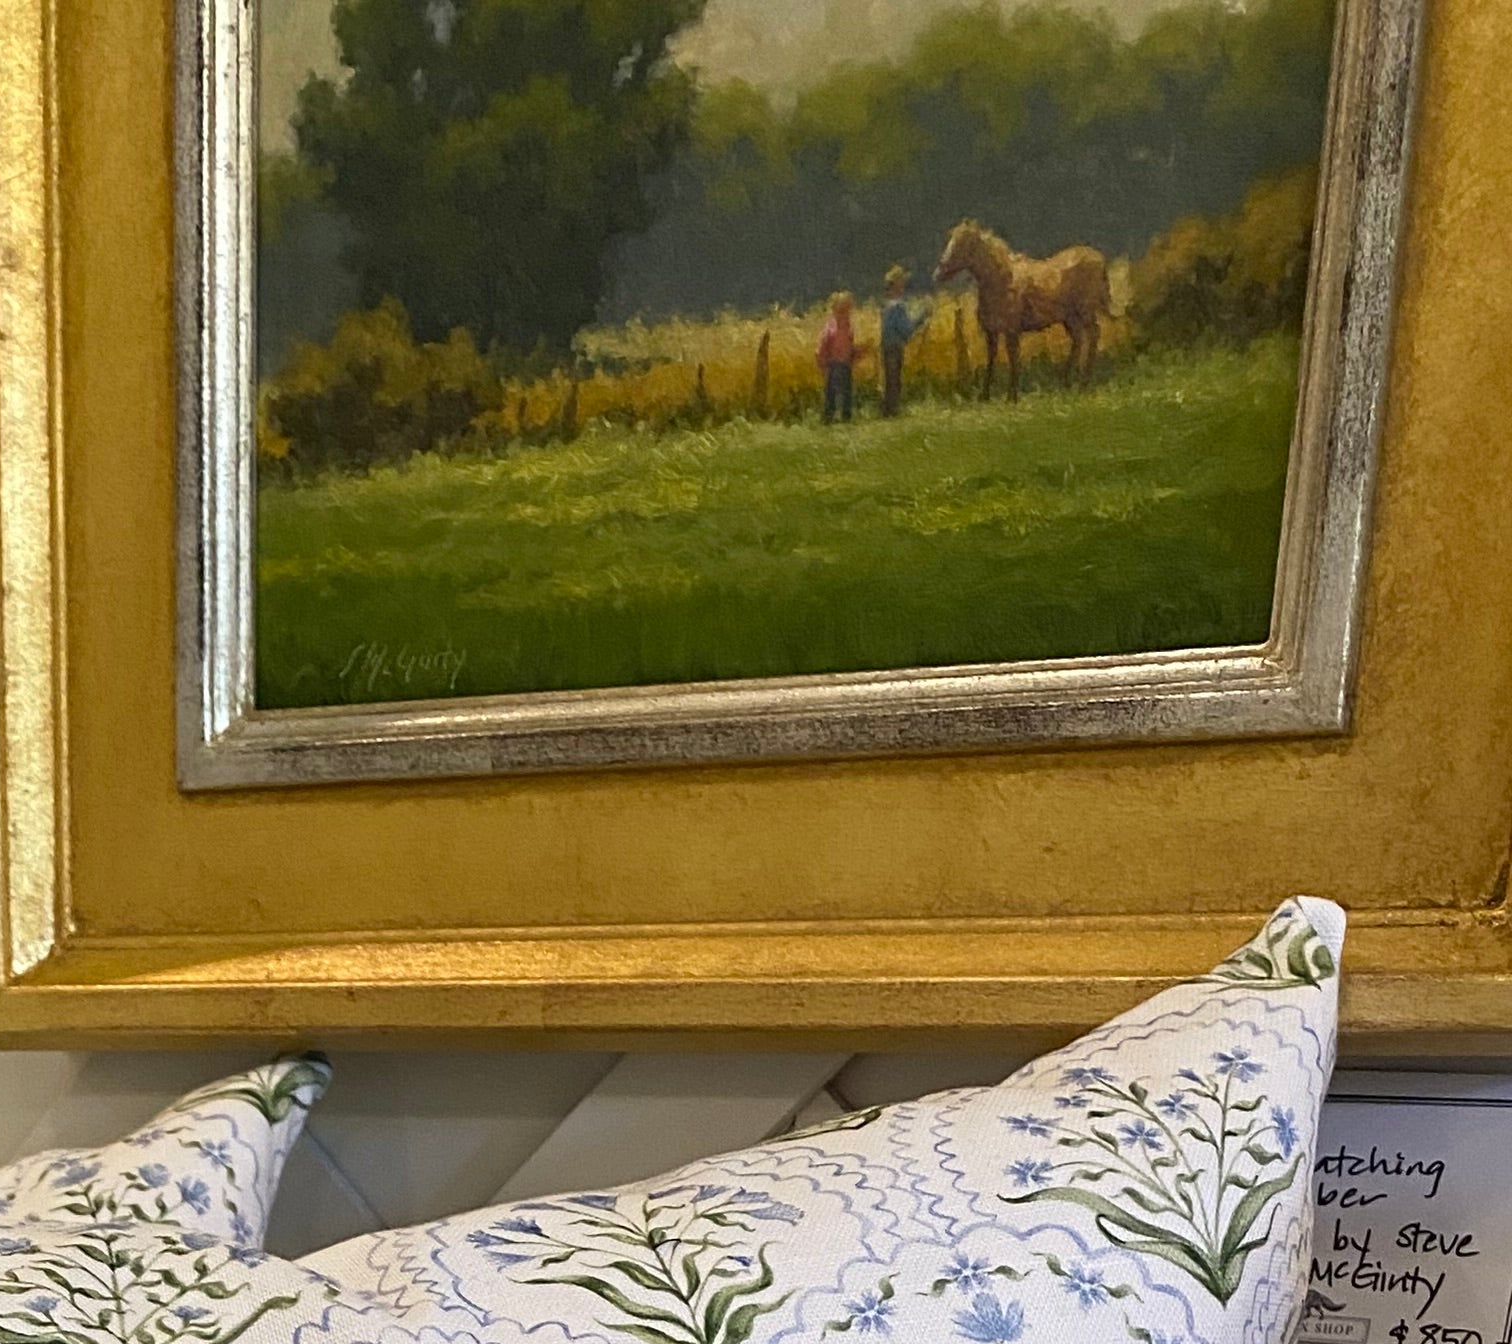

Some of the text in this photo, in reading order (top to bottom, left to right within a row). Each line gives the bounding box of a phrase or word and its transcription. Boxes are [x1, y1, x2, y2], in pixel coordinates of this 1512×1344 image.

[1314, 1145, 1445, 1198] atching
[1317, 1182, 1388, 1208] ber
[1333, 1218, 1480, 1266] by Steve
[1309, 1257, 1445, 1320] McGinty
[1314, 1322, 1354, 1336] SHOP
